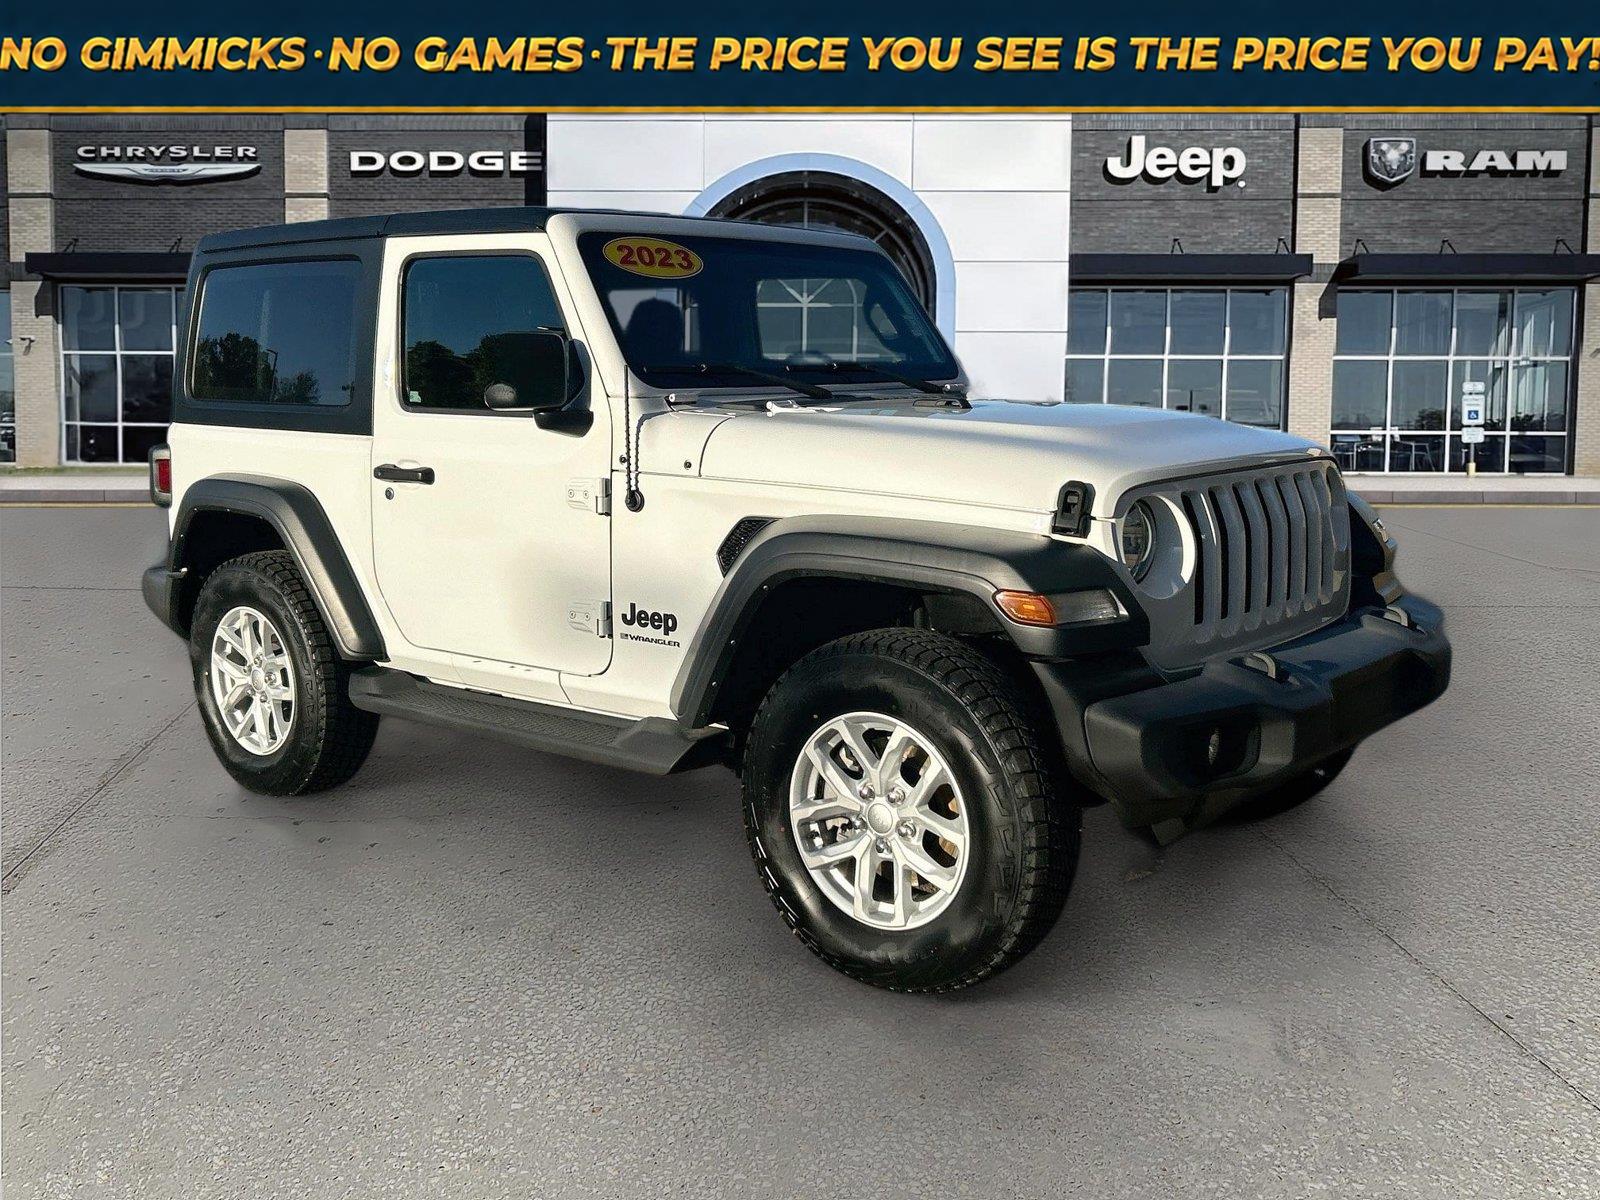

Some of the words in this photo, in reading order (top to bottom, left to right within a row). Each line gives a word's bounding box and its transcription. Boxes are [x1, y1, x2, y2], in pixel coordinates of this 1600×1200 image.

[76, 145, 258, 158] CHRYSLER
[350, 150, 542, 172] DODGE
[1106, 135, 1247, 187] Jeep
[1425, 150, 1568, 171] RAM
[616, 244, 696, 270] 2023
[621, 602, 678, 636] Jeep
[628, 634, 681, 648] WRANGLER
